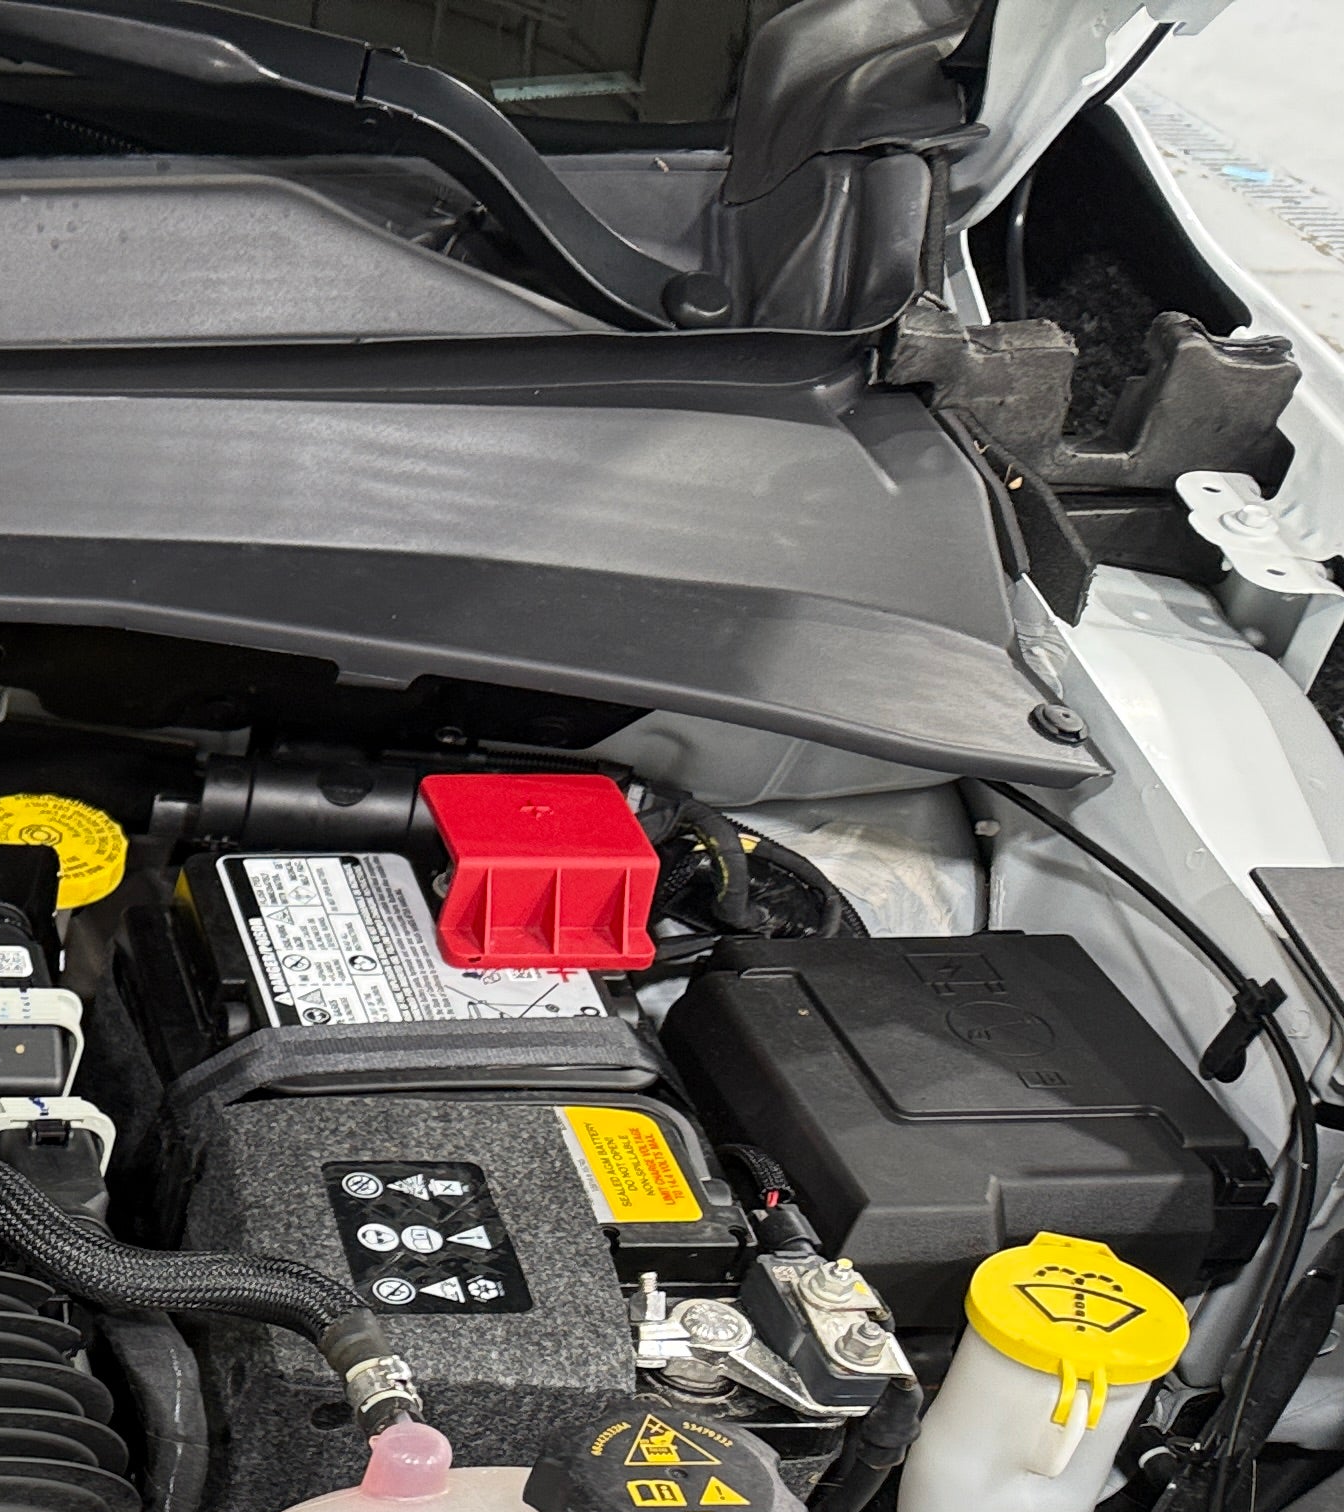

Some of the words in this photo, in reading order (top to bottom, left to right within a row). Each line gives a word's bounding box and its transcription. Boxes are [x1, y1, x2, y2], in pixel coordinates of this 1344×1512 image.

[584, 1122, 608, 1156] BATTERY
[629, 1128, 651, 1157] VOLTAGE
[600, 1158, 615, 1175] AGM
[616, 1163, 631, 1178] NOT
[618, 1135, 656, 1196] NON-SPILLABLE
[644, 1159, 665, 1186] CHARGE
[654, 1152, 671, 1173] VOLTS
[610, 1177, 632, 1207] SEALED
[624, 1179, 638, 1191] DO
[672, 1190, 685, 1199] TO
[658, 1187, 676, 1205] LIMIT
